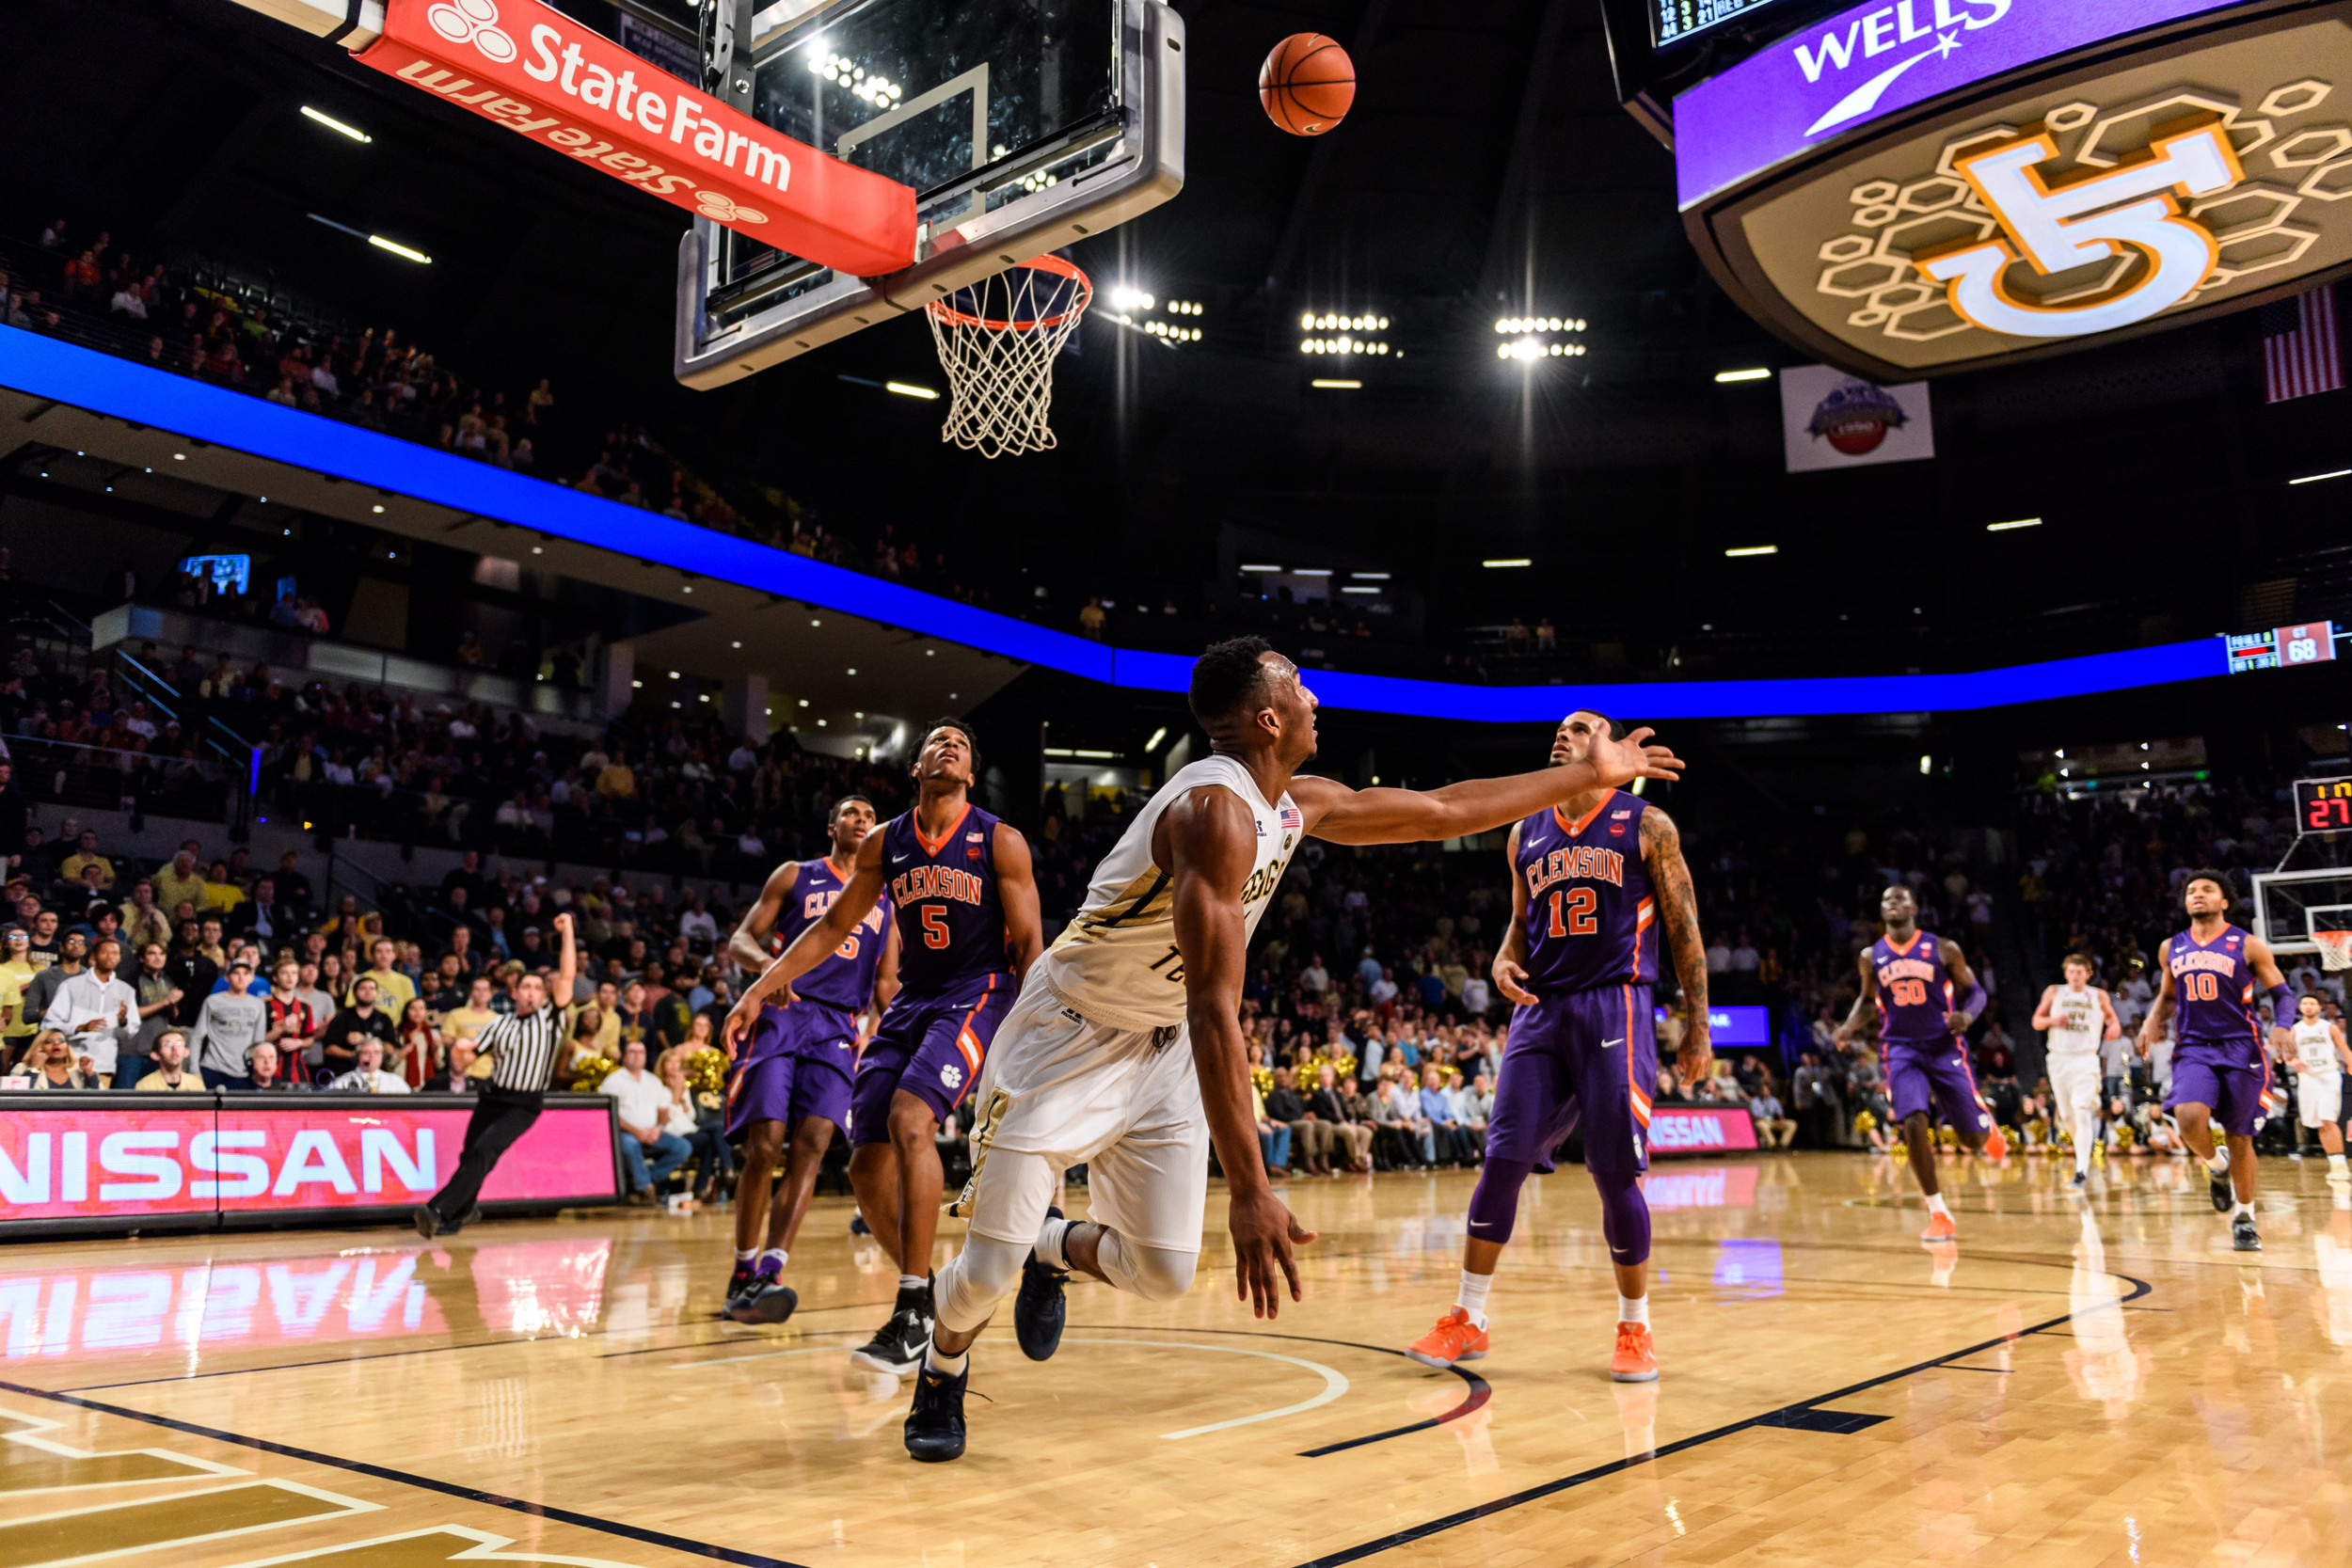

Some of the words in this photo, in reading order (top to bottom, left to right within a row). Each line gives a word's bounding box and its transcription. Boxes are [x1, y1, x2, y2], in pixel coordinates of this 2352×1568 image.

[1682, 15, 1693, 31] 3
[1793, 0, 2012, 84] WELLS
[2287, 638, 2317, 662] 68
[2310, 798, 2350, 828] 27
[892, 864, 982, 910] CLEMSON
[1526, 846, 1624, 899] CLEMSON
[921, 904, 950, 950] 5
[1548, 886, 1597, 939] 12
[1890, 979, 1927, 1006] 50
[2184, 973, 2218, 1002] 10
[0, 1129, 437, 1204] NISSAN
